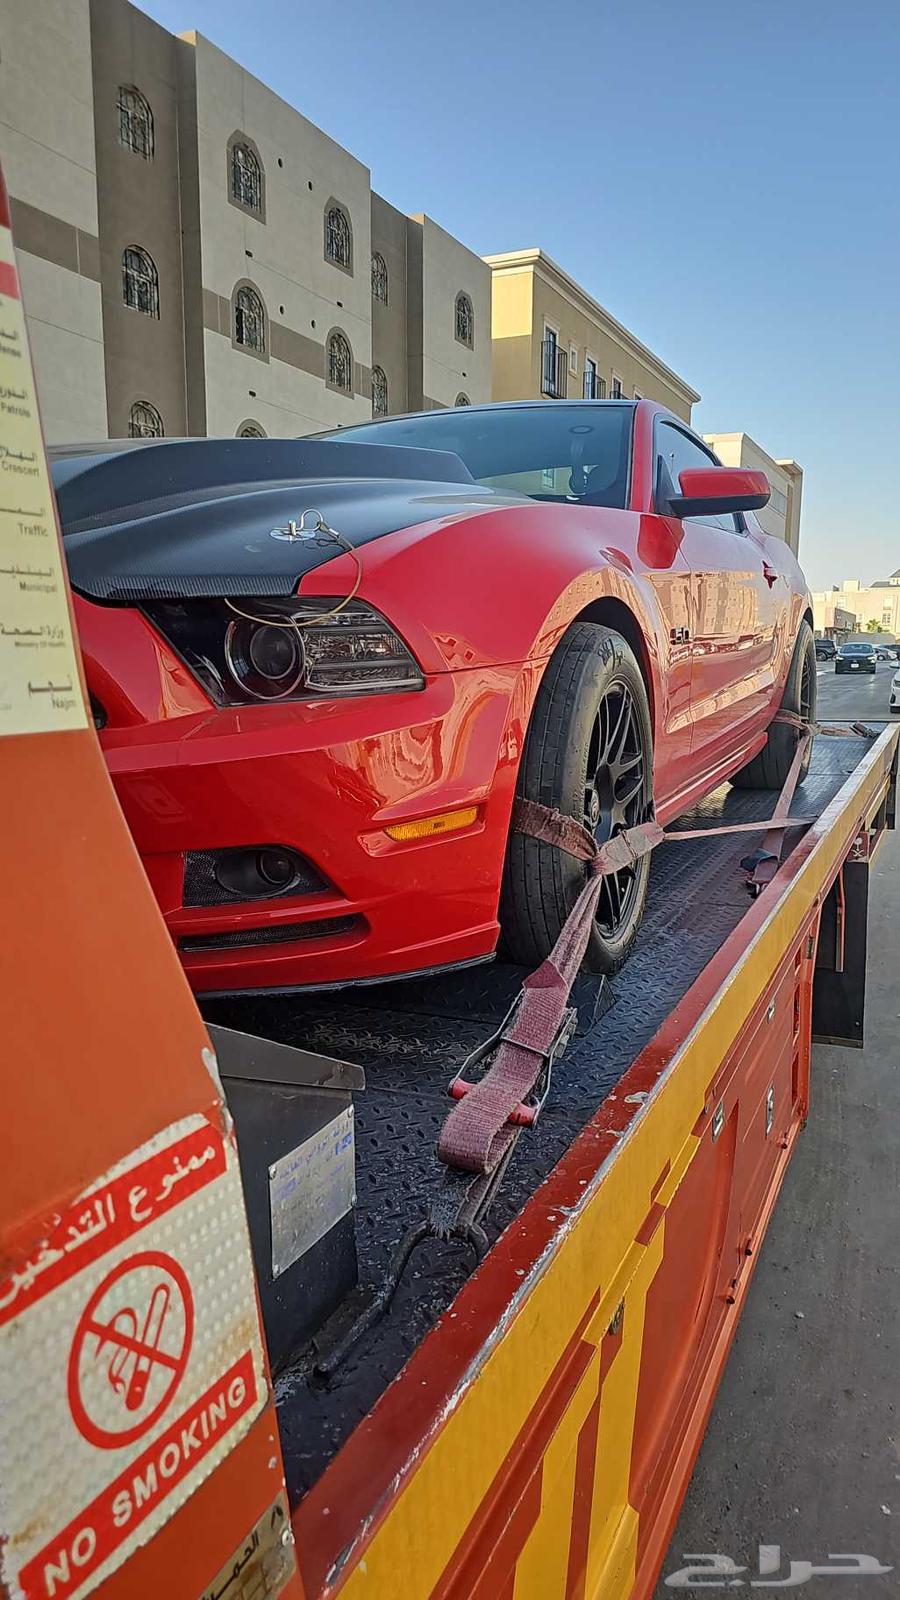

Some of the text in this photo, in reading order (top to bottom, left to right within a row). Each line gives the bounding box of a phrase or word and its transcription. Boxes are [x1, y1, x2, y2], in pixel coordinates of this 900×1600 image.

[18, 522, 49, 537] Traffic
[28, 674, 73, 699] نجم
[52, 698, 77, 711] Najm
[129, 1145, 216, 1223] ممنوع
[44, 1375, 247, 1597] NO SMOKING
